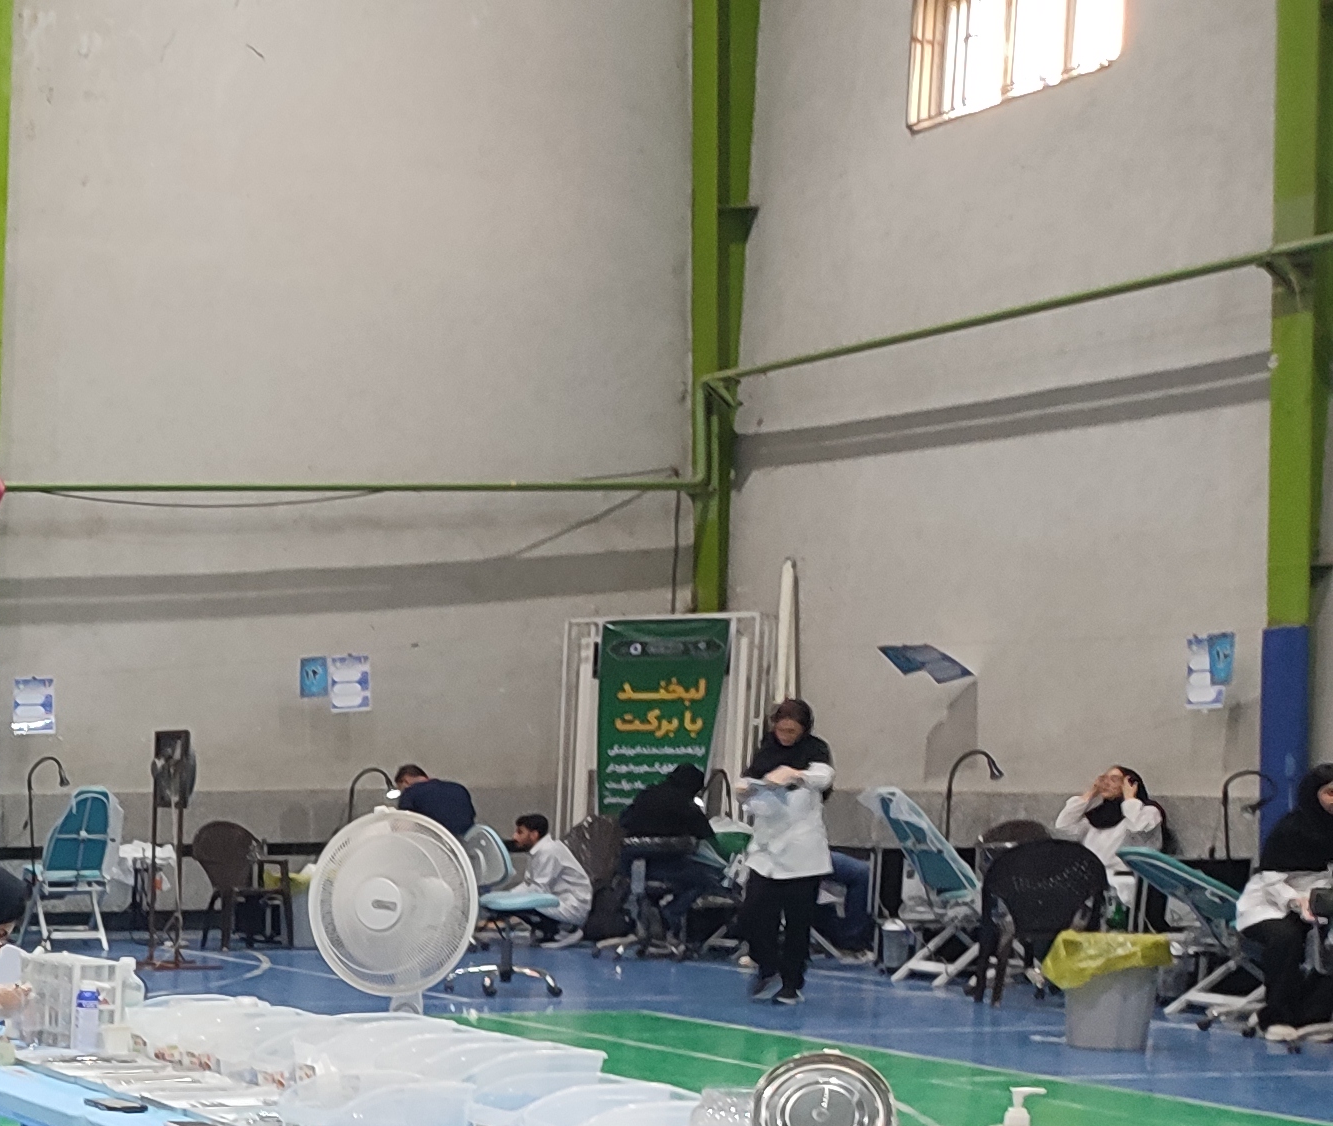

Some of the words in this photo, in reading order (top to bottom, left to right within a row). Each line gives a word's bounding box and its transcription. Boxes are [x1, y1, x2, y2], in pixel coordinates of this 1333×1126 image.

[616, 677, 707, 706] لبخند
[615, 708, 679, 738] برکت
[684, 710, 703, 738] با
